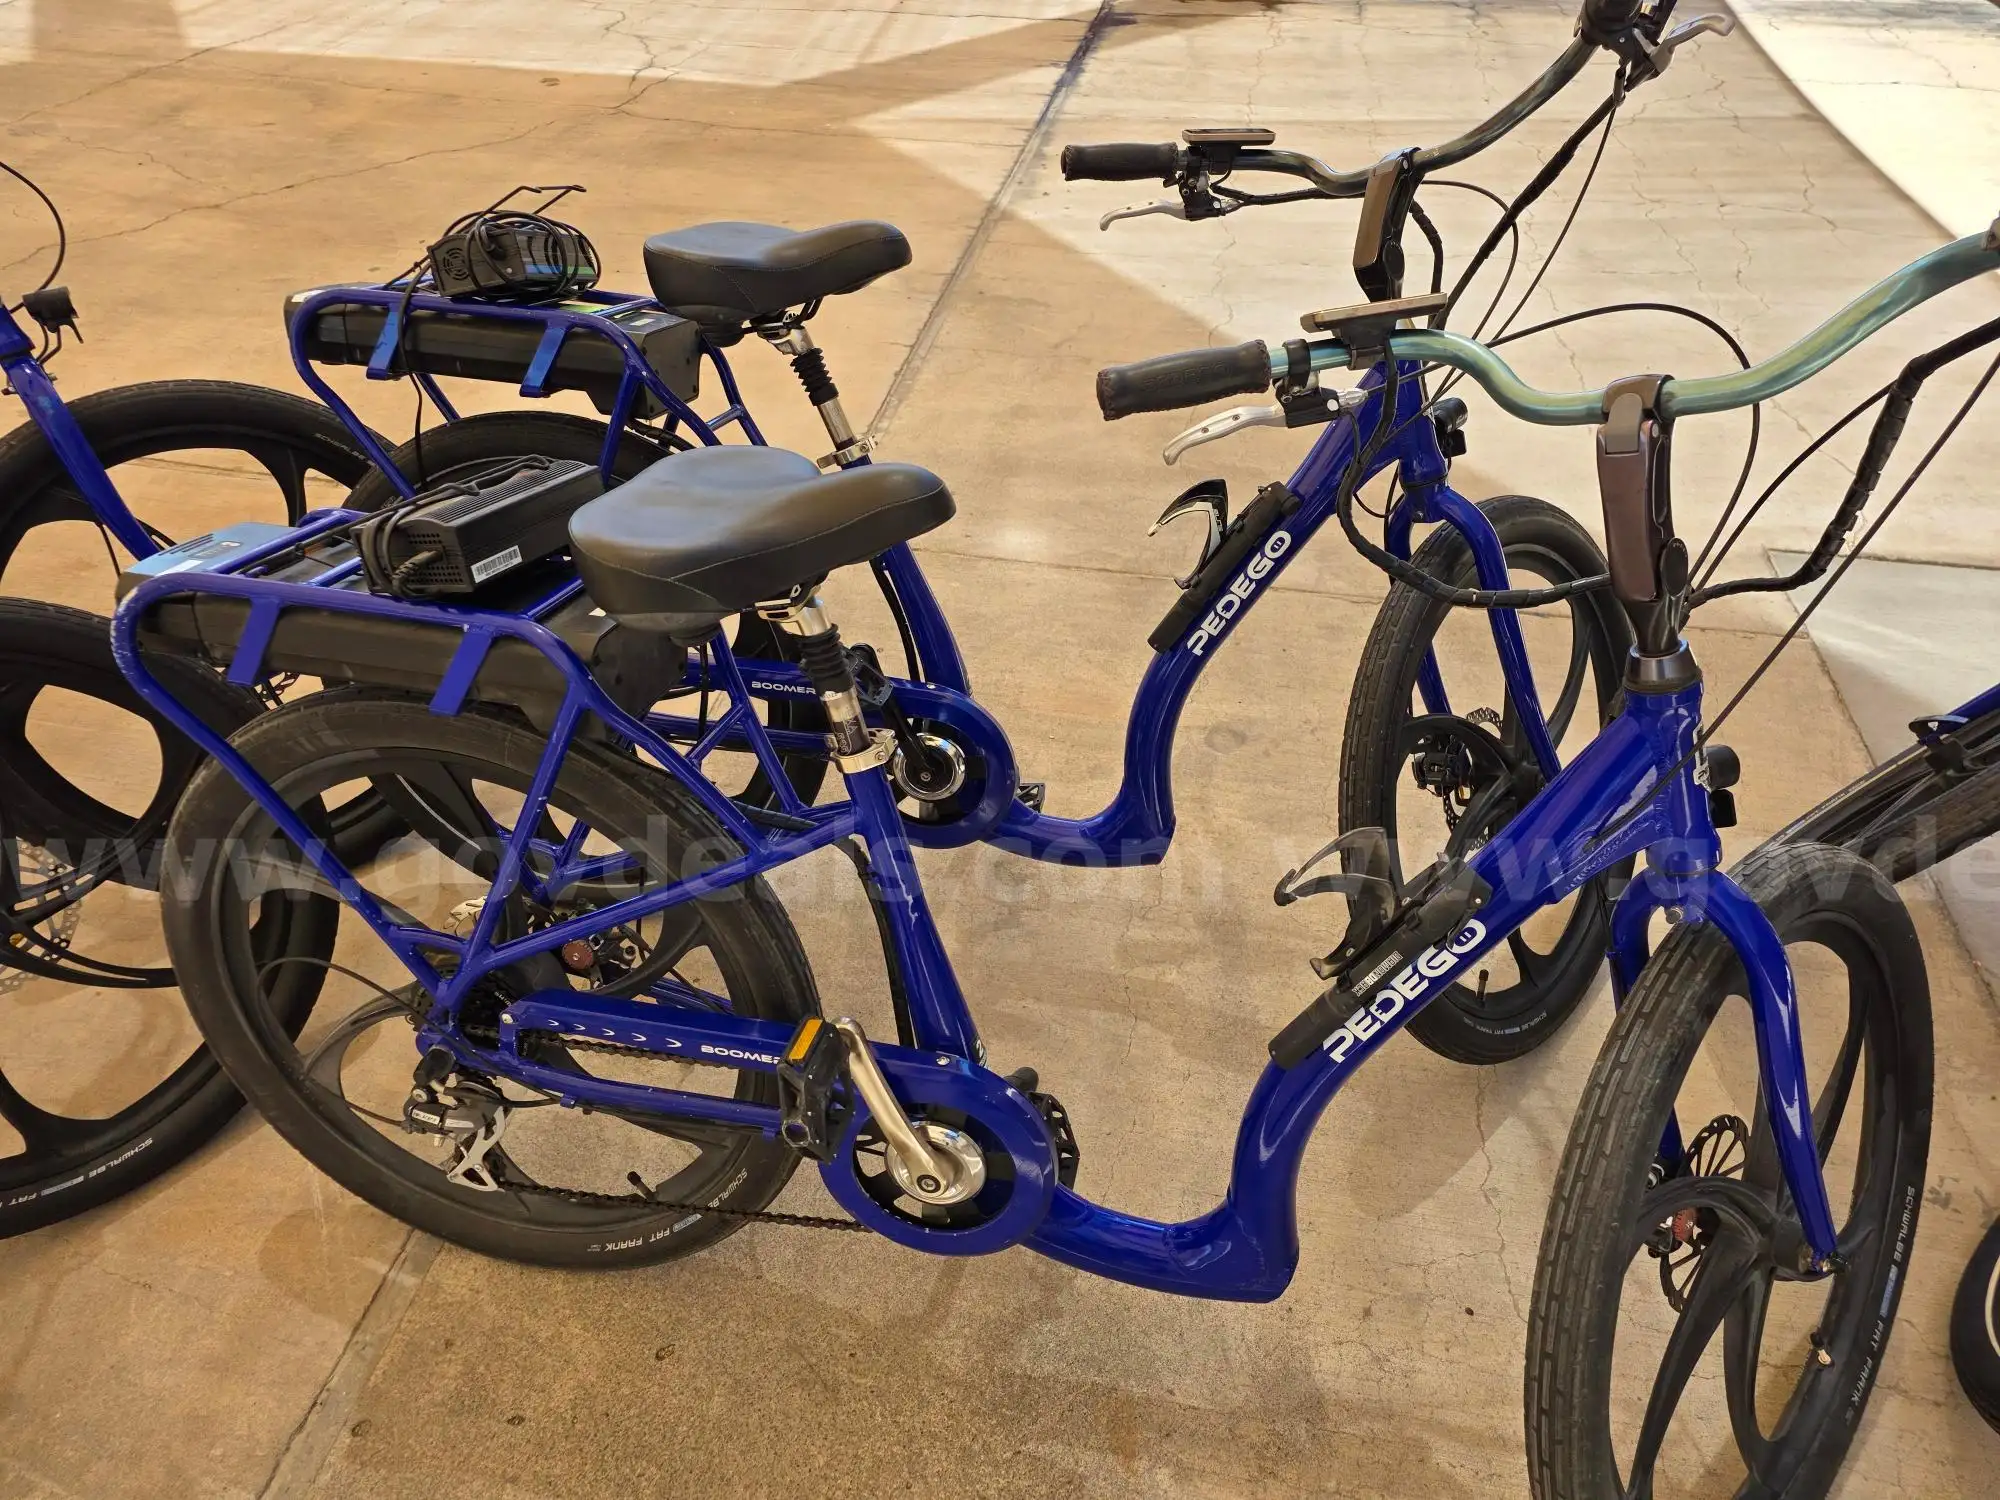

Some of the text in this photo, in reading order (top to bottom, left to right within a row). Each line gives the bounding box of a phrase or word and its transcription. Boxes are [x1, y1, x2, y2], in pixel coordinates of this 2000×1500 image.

[1187, 530, 1292, 656] PEDEGO
[751, 681, 816, 695] BOOMER
[1322, 918, 1487, 1064] PEDEGO
[1351, 950, 1404, 997] DIAMONDBACK
[8, 1137, 153, 1206] SCHWALBE FAT
[604, 1236, 643, 1252] FRANK
[649, 1227, 670, 1242] FAT
[1851, 1185, 1915, 1406] SCHWALBE FAT FRANK
